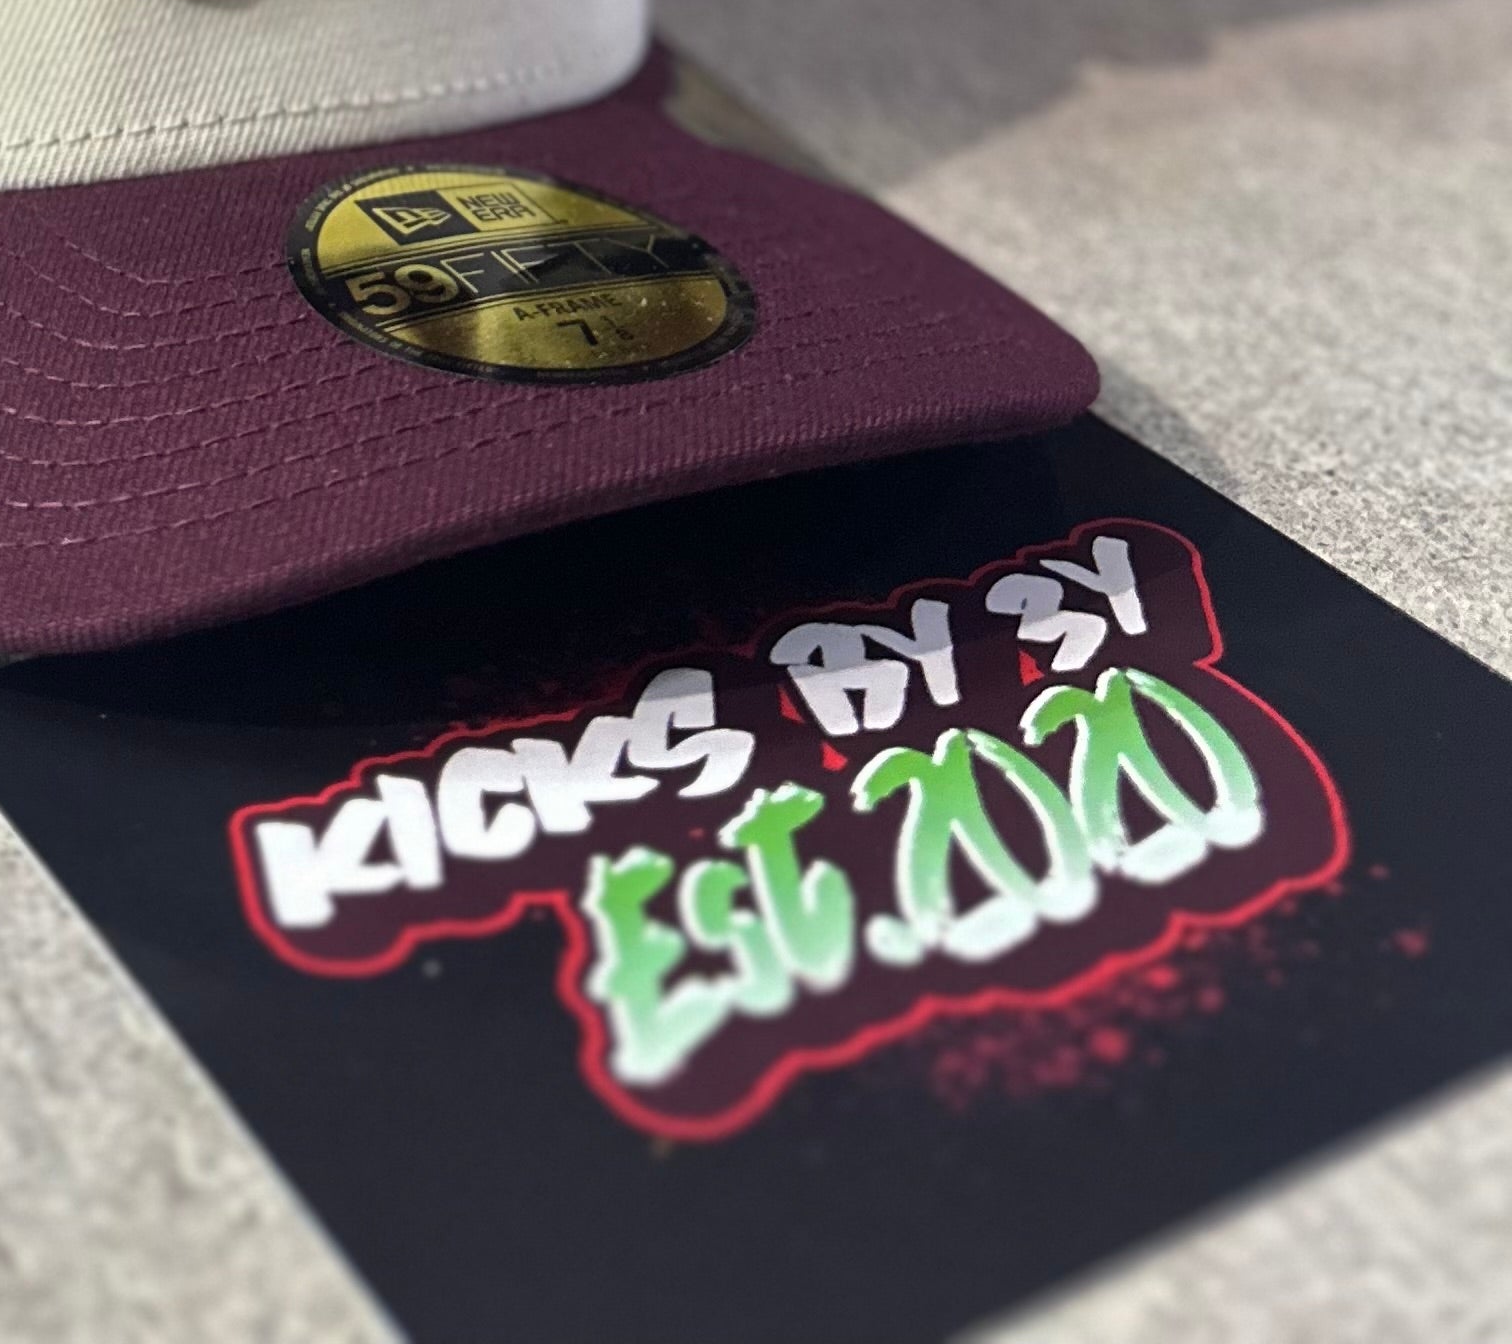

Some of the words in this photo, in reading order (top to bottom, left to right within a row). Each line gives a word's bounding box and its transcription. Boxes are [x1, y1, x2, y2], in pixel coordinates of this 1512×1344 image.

[455, 191, 522, 210] NEW
[471, 204, 537, 223] ERA
[344, 234, 670, 316] 59FIFTY
[512, 293, 623, 321] A-FRAME
[556, 318, 599, 346] 7
[255, 667, 755, 928] KICKS
[769, 600, 959, 736] BY
